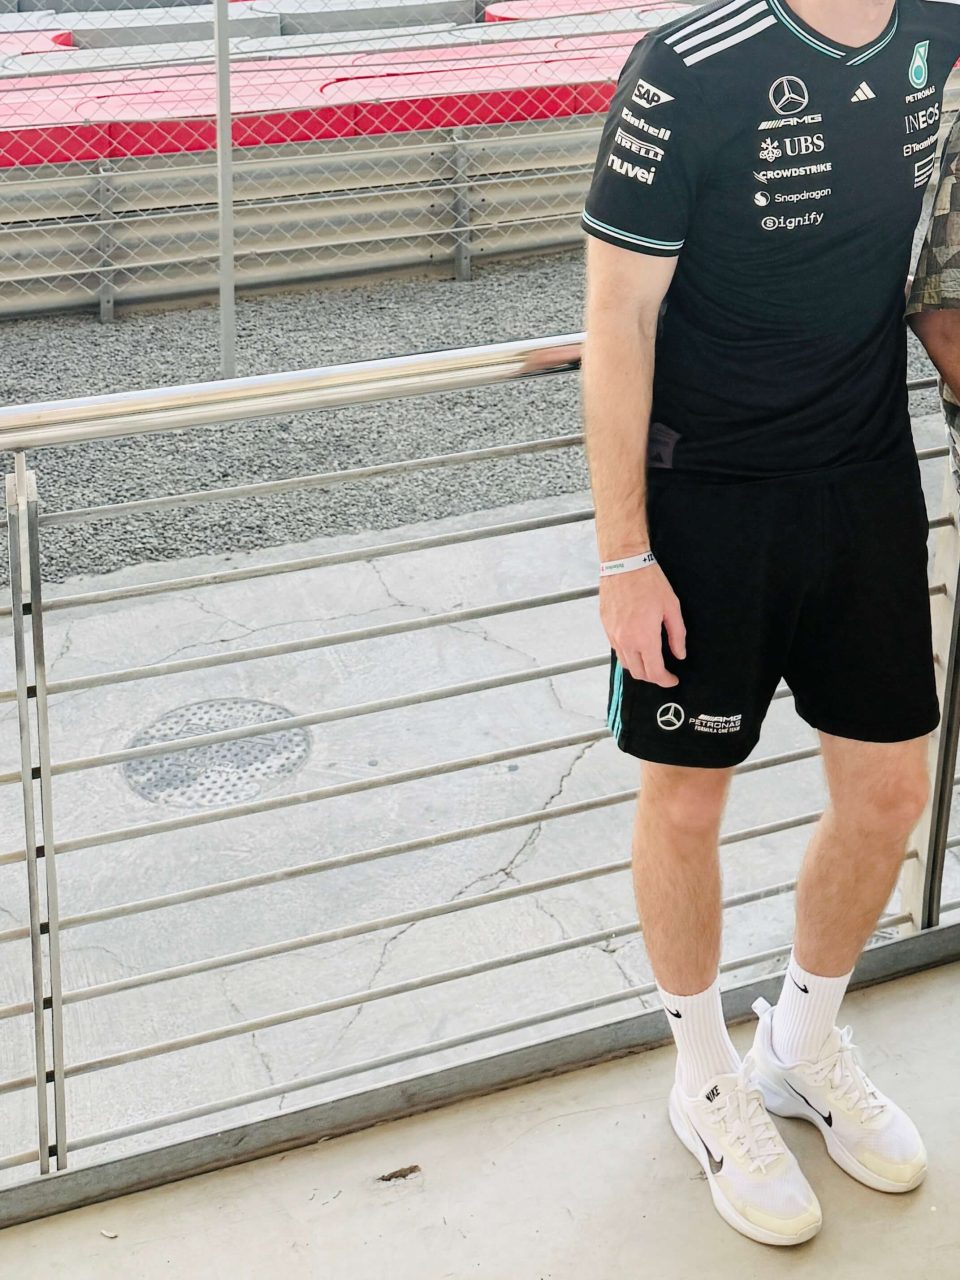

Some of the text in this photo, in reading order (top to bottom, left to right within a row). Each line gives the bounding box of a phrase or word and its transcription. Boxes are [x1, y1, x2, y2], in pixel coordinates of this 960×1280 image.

[634, 83, 661, 106] SAP
[905, 85, 936, 104] PETRONAS
[621, 106, 672, 141] Einhell
[776, 113, 823, 128] AMG
[904, 102, 939, 134] INEOS
[614, 126, 665, 162] PIRELLI
[783, 133, 825, 156] UBS
[607, 153, 656, 185] nuvei
[758, 162, 832, 181] CROWDSTRIKE
[774, 188, 832, 203] Snapdragon
[688, 717, 741, 729] PETRONAS
[705, 1084, 720, 1103] NIKE
